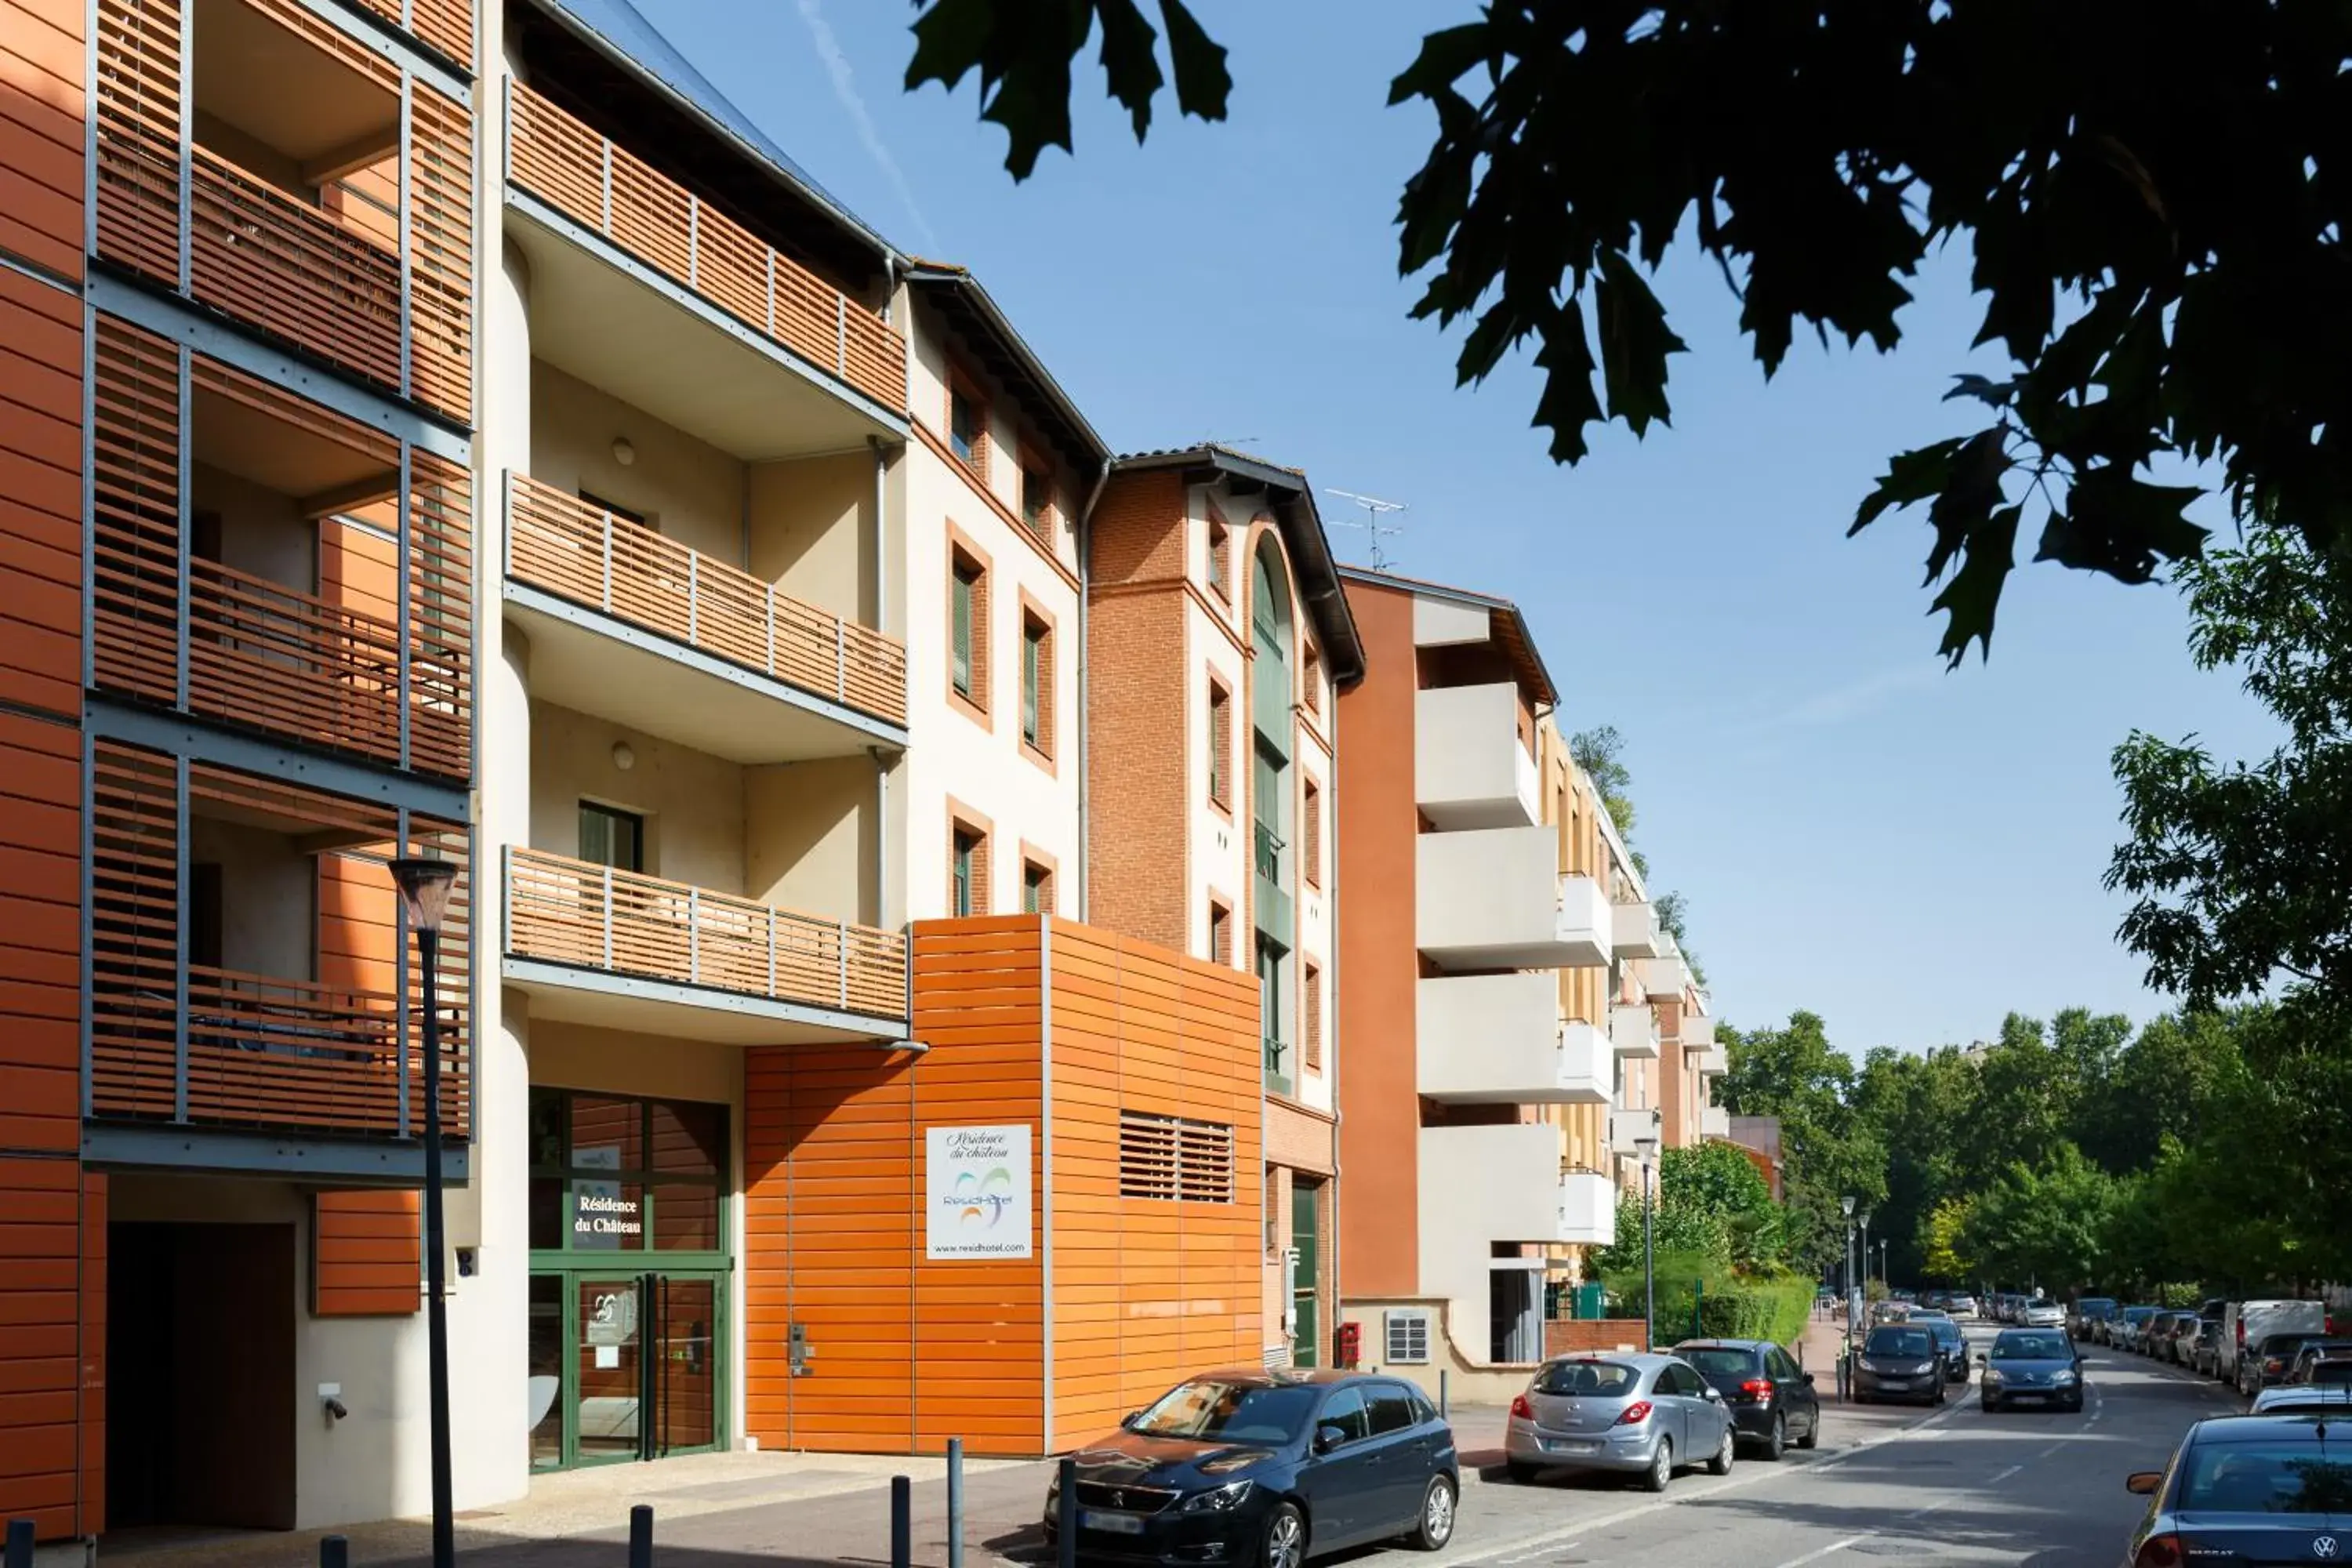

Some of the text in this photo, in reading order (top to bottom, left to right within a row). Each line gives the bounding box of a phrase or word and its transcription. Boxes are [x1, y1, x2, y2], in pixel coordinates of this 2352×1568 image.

[946, 1131, 1004, 1149] Résidence
[949, 1146, 964, 1158] du
[579, 1196, 638, 1213] Résidence
[575, 1218, 641, 1233] du Château
[935, 1243, 1025, 1253] www.residhotel.com
